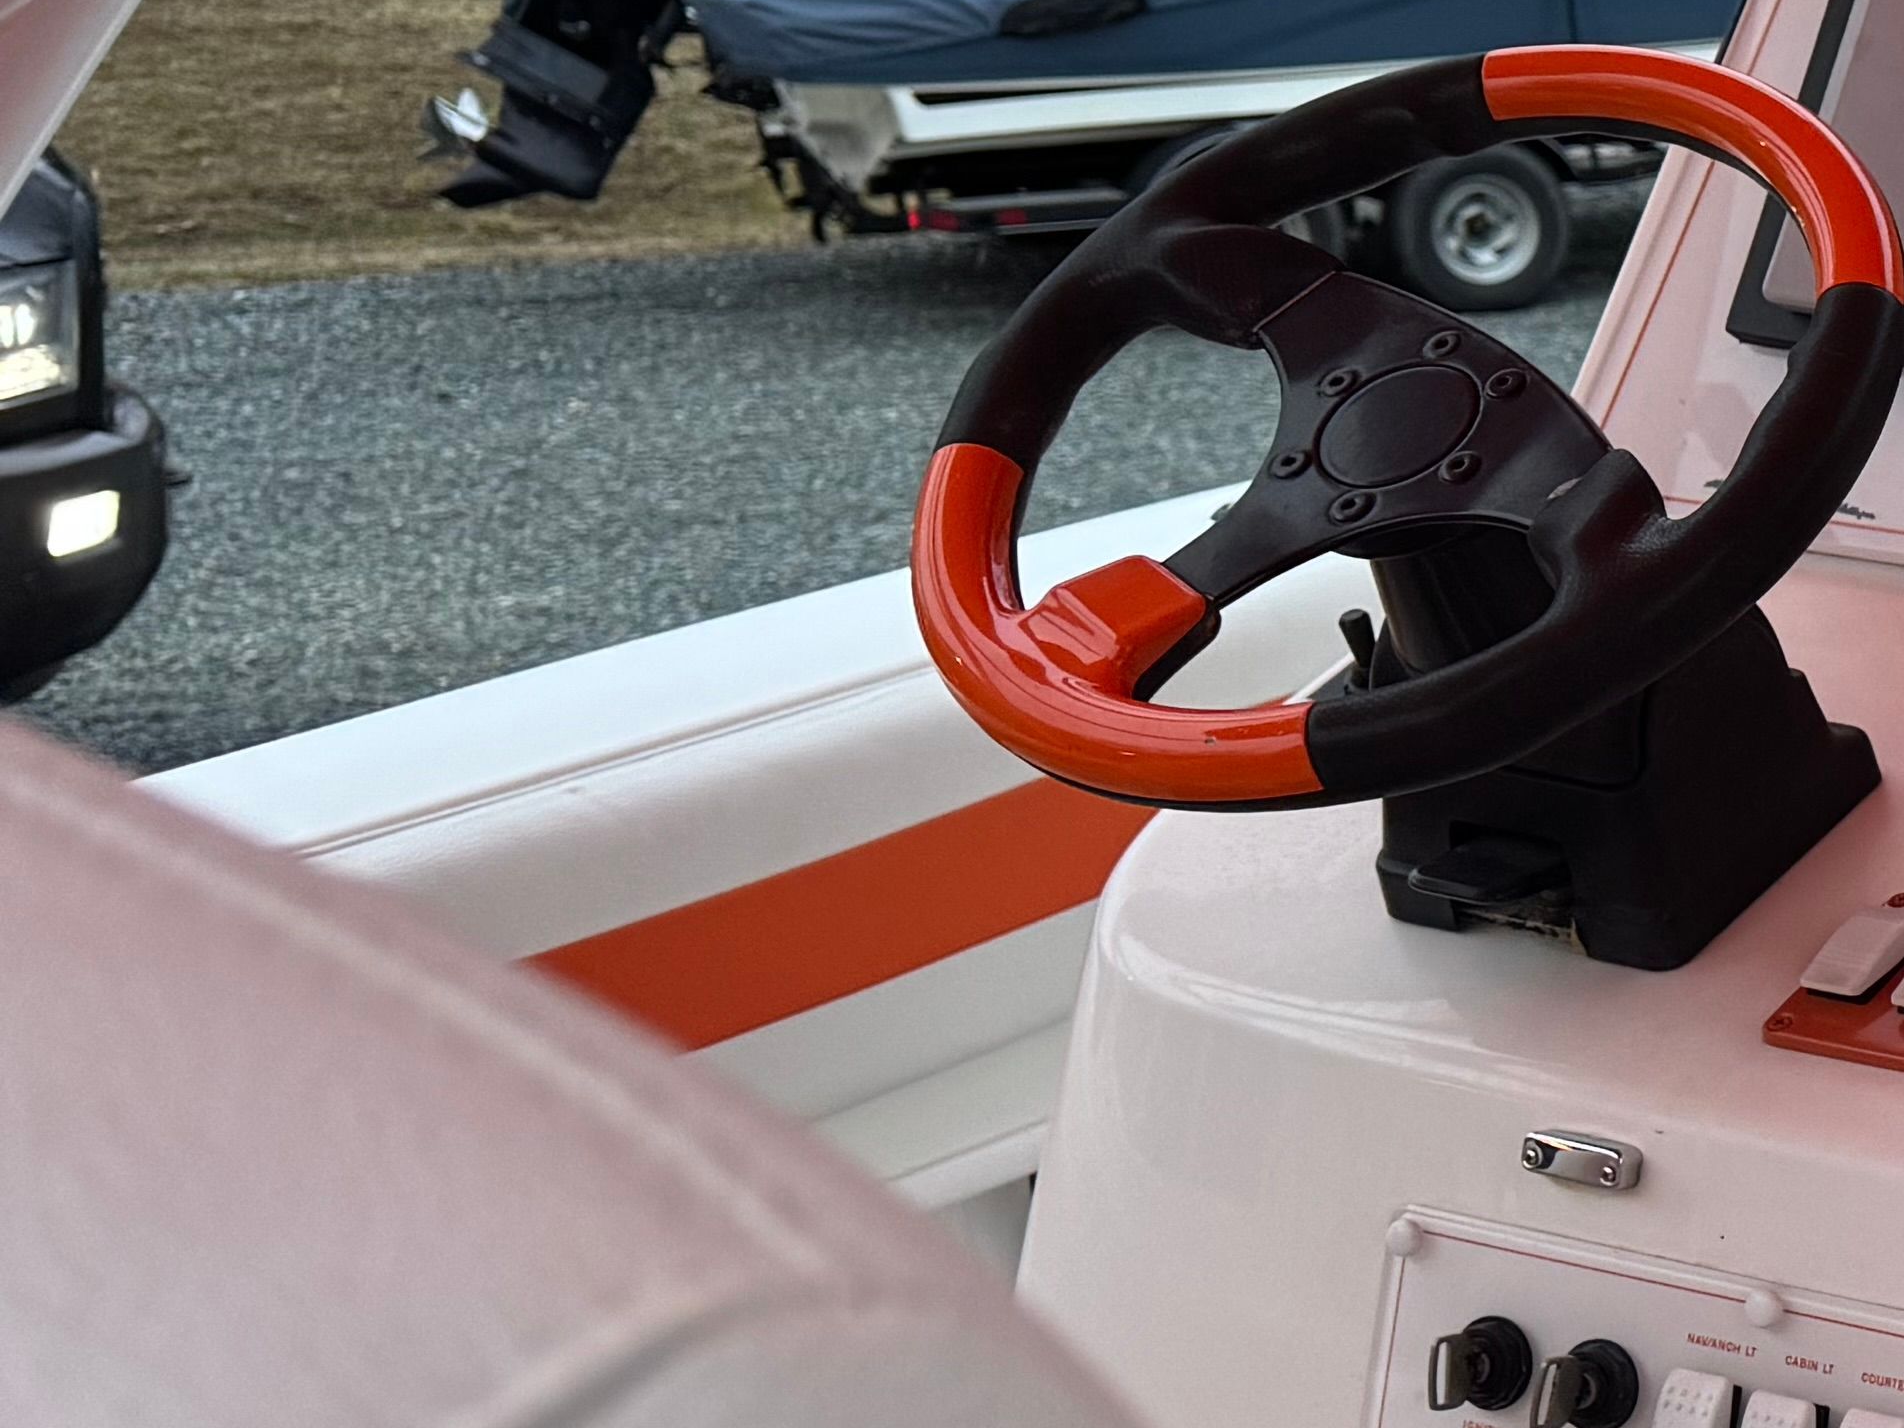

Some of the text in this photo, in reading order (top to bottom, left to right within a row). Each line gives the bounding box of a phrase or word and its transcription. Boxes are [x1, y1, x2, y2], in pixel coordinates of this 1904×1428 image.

[1745, 1346, 1757, 1357] LT
[1785, 1355, 1834, 1375] CABIN LT
